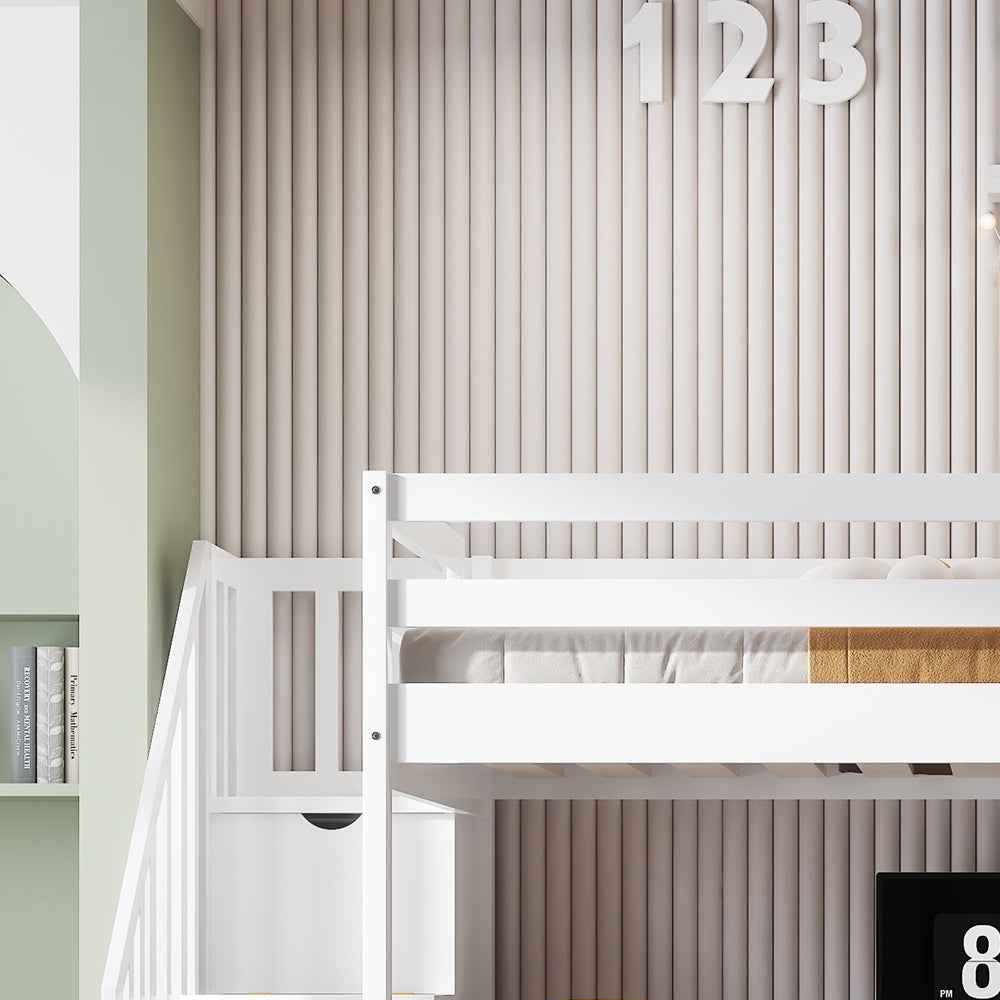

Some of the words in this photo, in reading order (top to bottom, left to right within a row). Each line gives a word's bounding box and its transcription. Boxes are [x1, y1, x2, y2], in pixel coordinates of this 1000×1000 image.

[23, 665, 31, 701] RECOVERY
[70, 674, 78, 705] Primary
[23, 715, 31, 742] MENTAL
[70, 711, 78, 760] Mathematics
[23, 743, 31, 769] HEALTH
[940, 989, 953, 998] PM
